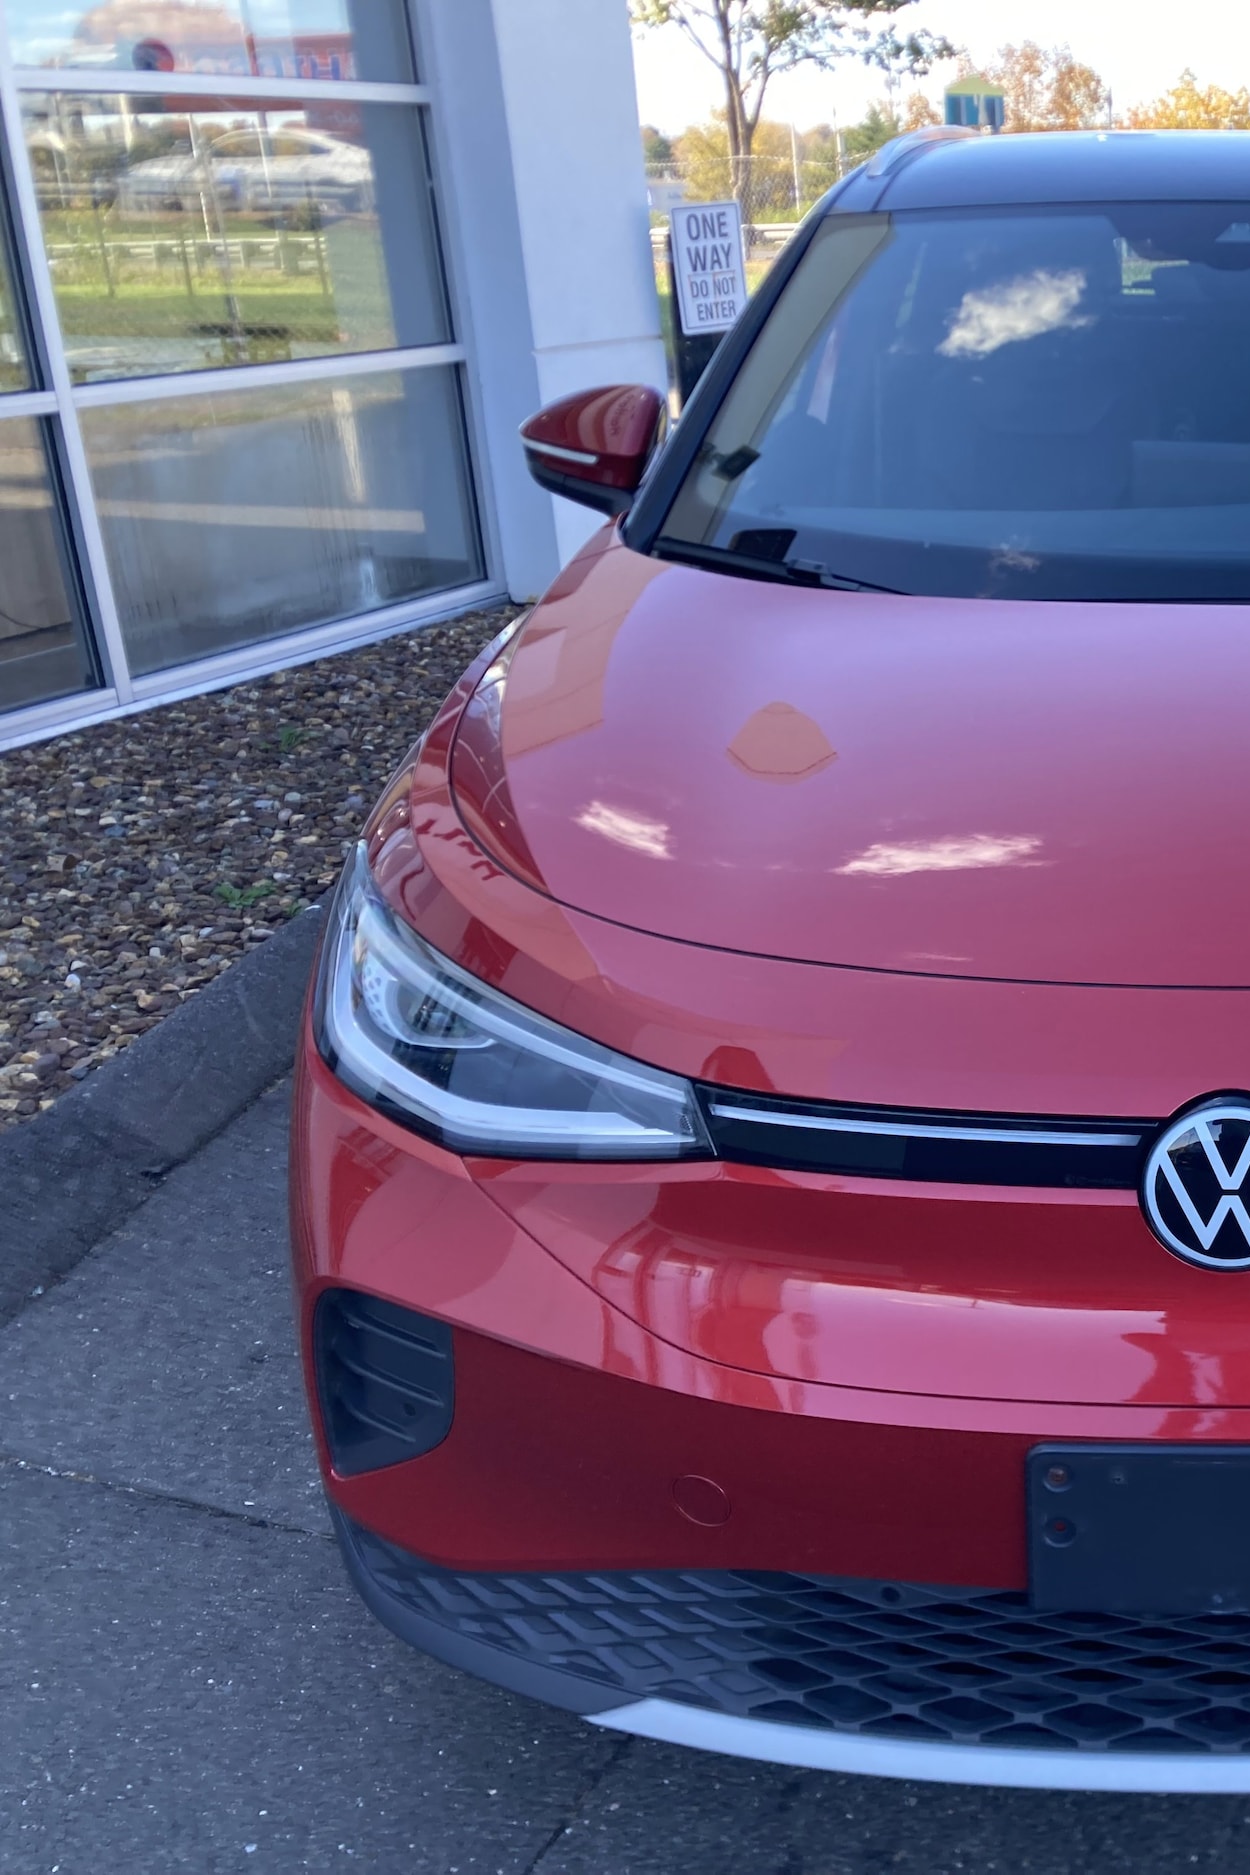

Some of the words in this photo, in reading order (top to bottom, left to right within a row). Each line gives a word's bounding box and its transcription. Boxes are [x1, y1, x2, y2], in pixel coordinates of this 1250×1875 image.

[686, 211, 729, 241] ONE
[686, 242, 732, 273] WAY
[690, 280, 709, 298] DO
[713, 276, 736, 296] NOT
[697, 300, 737, 321] ENTER
